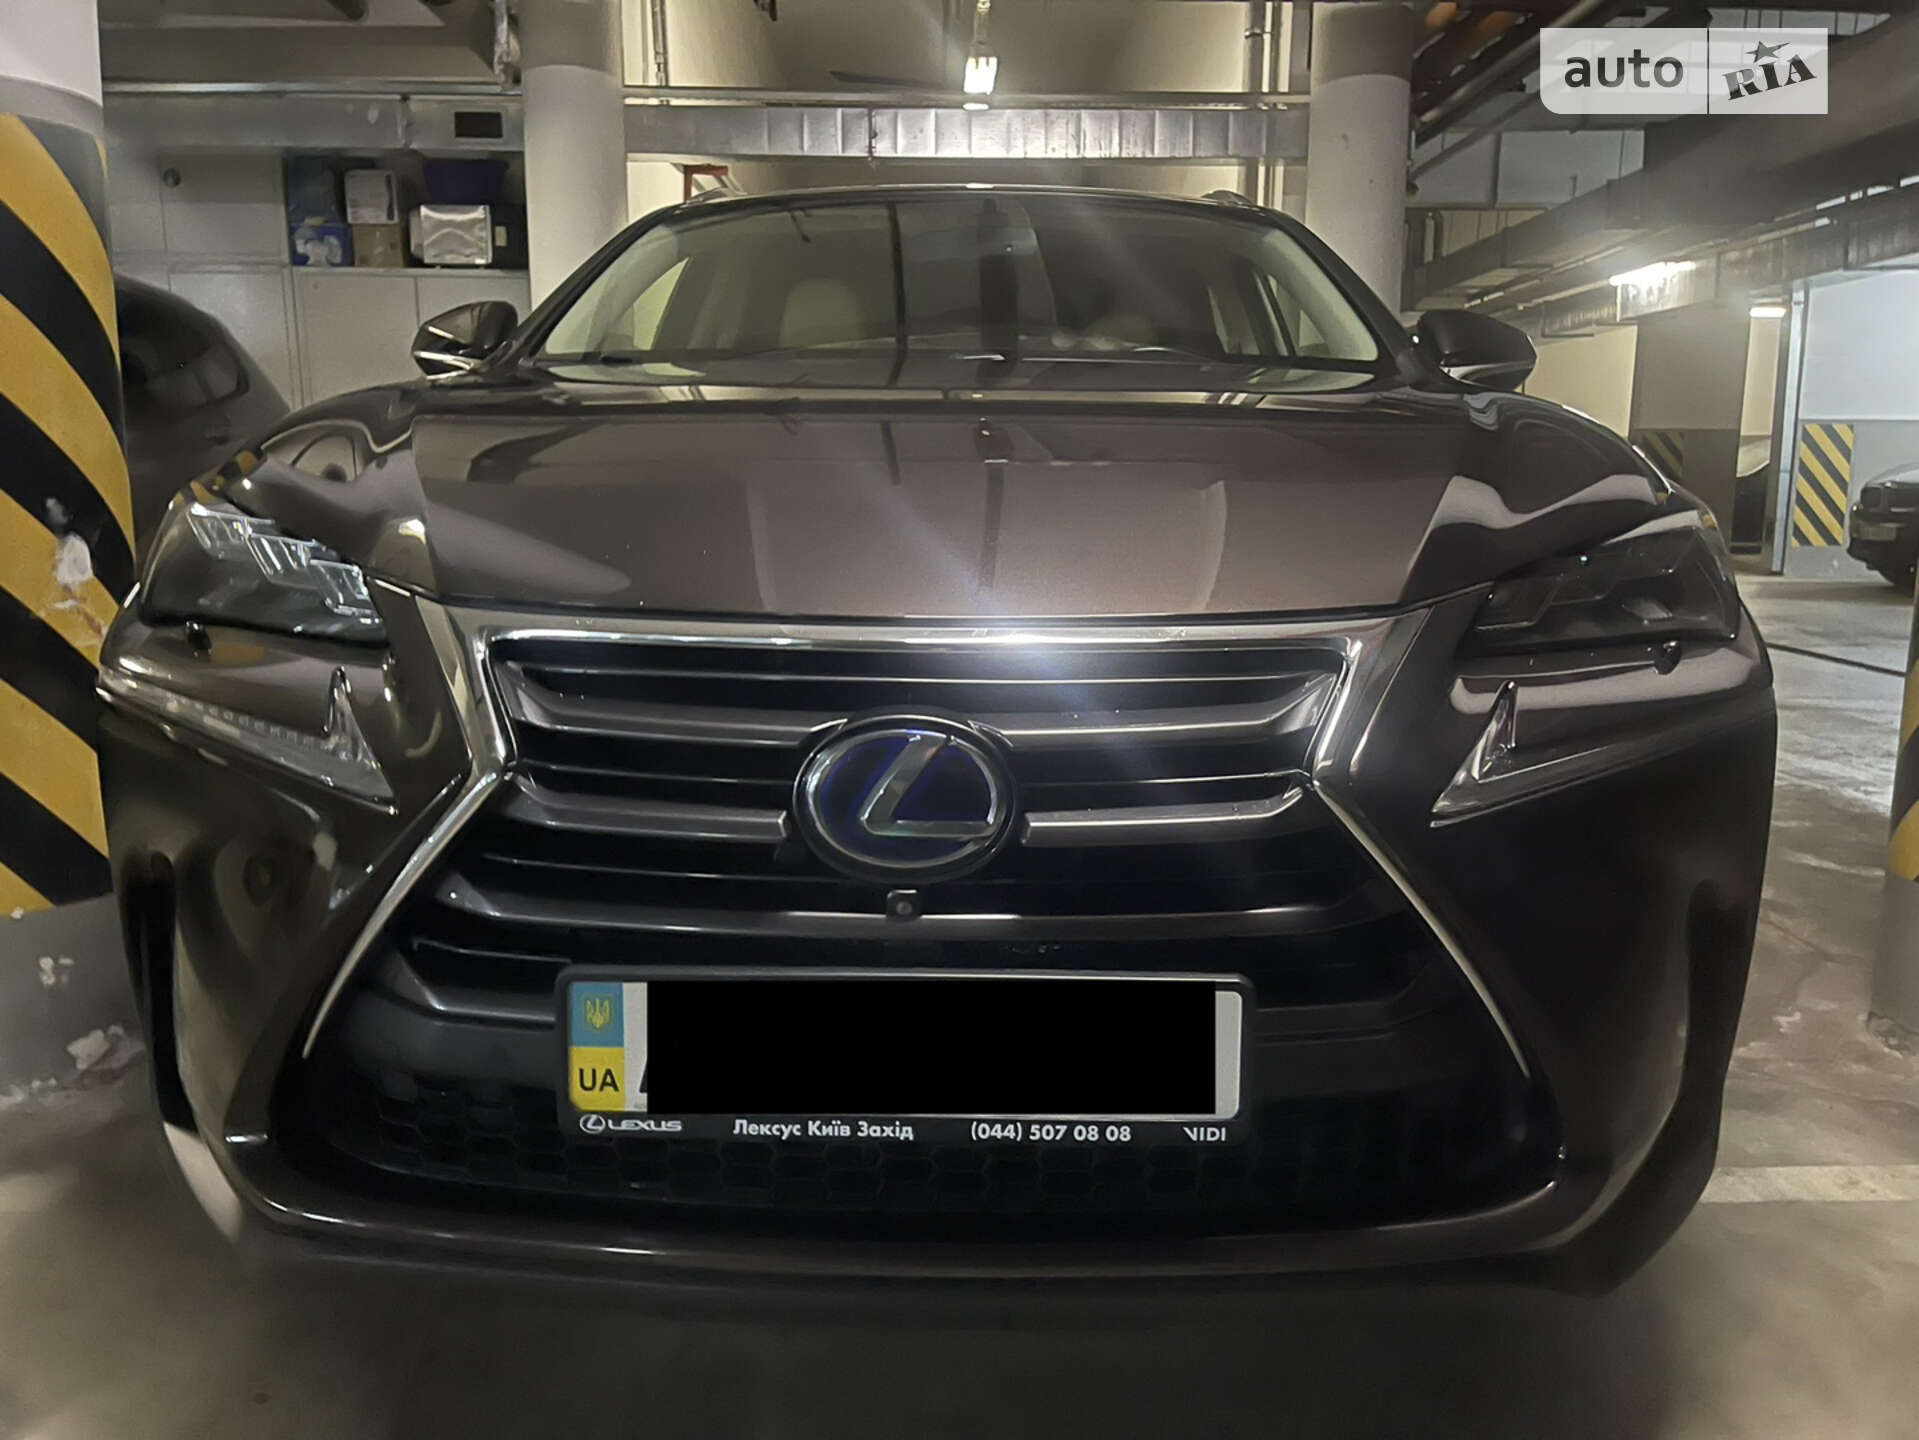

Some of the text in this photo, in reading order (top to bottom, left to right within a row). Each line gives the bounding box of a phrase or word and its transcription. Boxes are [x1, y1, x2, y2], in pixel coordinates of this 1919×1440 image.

[578, 1067, 620, 1093] UA
[608, 1119, 683, 1133] LEXUS
[732, 1118, 914, 1142] Лексус Київ Захід
[970, 1121, 1132, 1142] (044) 507 08 08
[1182, 1126, 1226, 1142] VIDI
